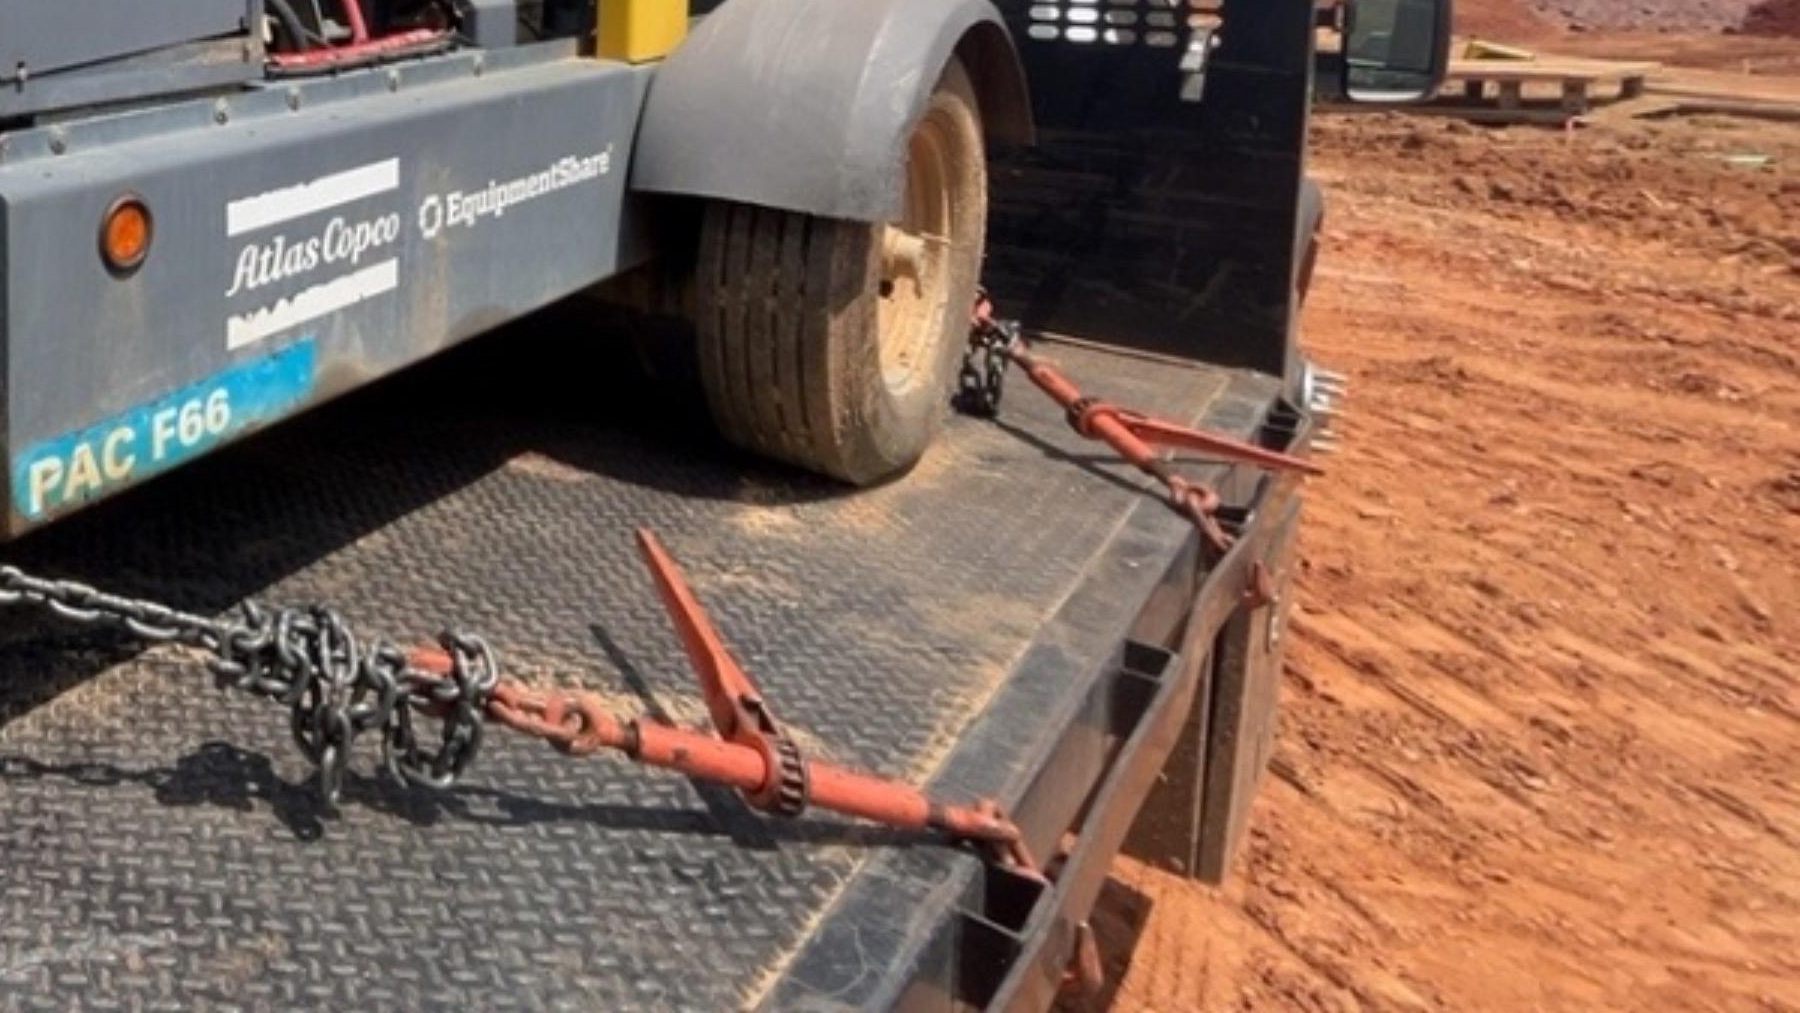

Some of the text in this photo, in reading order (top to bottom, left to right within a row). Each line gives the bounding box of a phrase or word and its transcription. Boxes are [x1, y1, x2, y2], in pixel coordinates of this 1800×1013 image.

[446, 152, 610, 227] EquipmentShare
[225, 212, 400, 298] Atlas Copco
[29, 388, 231, 515] PAC F66
